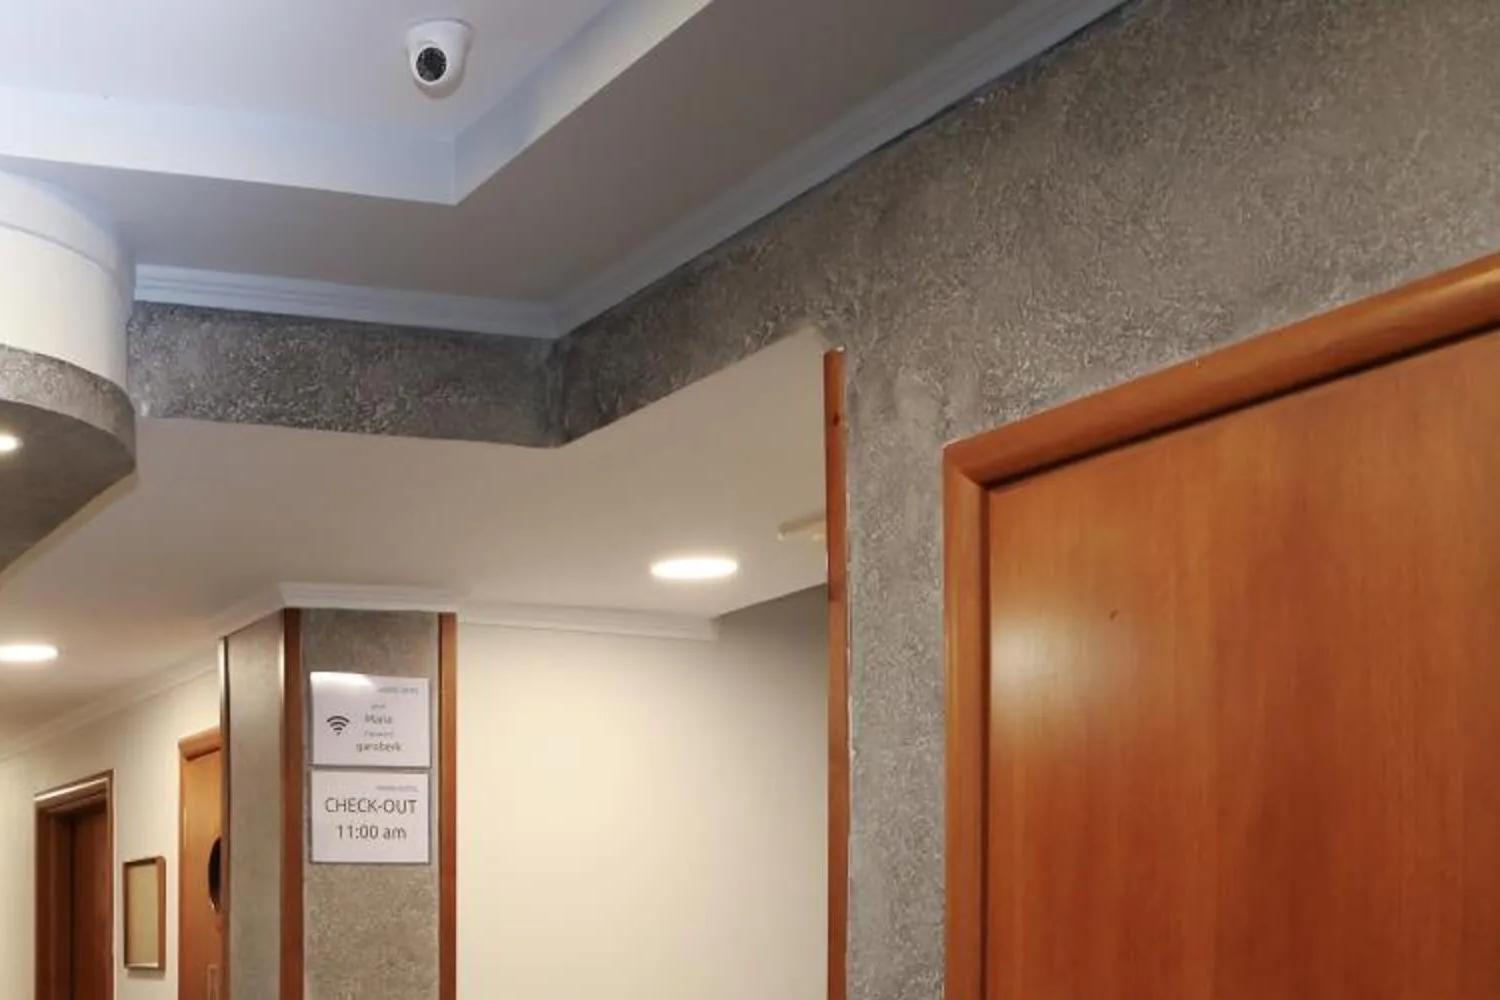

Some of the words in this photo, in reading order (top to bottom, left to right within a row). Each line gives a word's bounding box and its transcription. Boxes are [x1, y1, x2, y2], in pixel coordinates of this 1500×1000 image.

[324, 797, 418, 815] CHECK-OUT
[336, 824, 379, 840] 11:00
[382, 827, 408, 840] am
